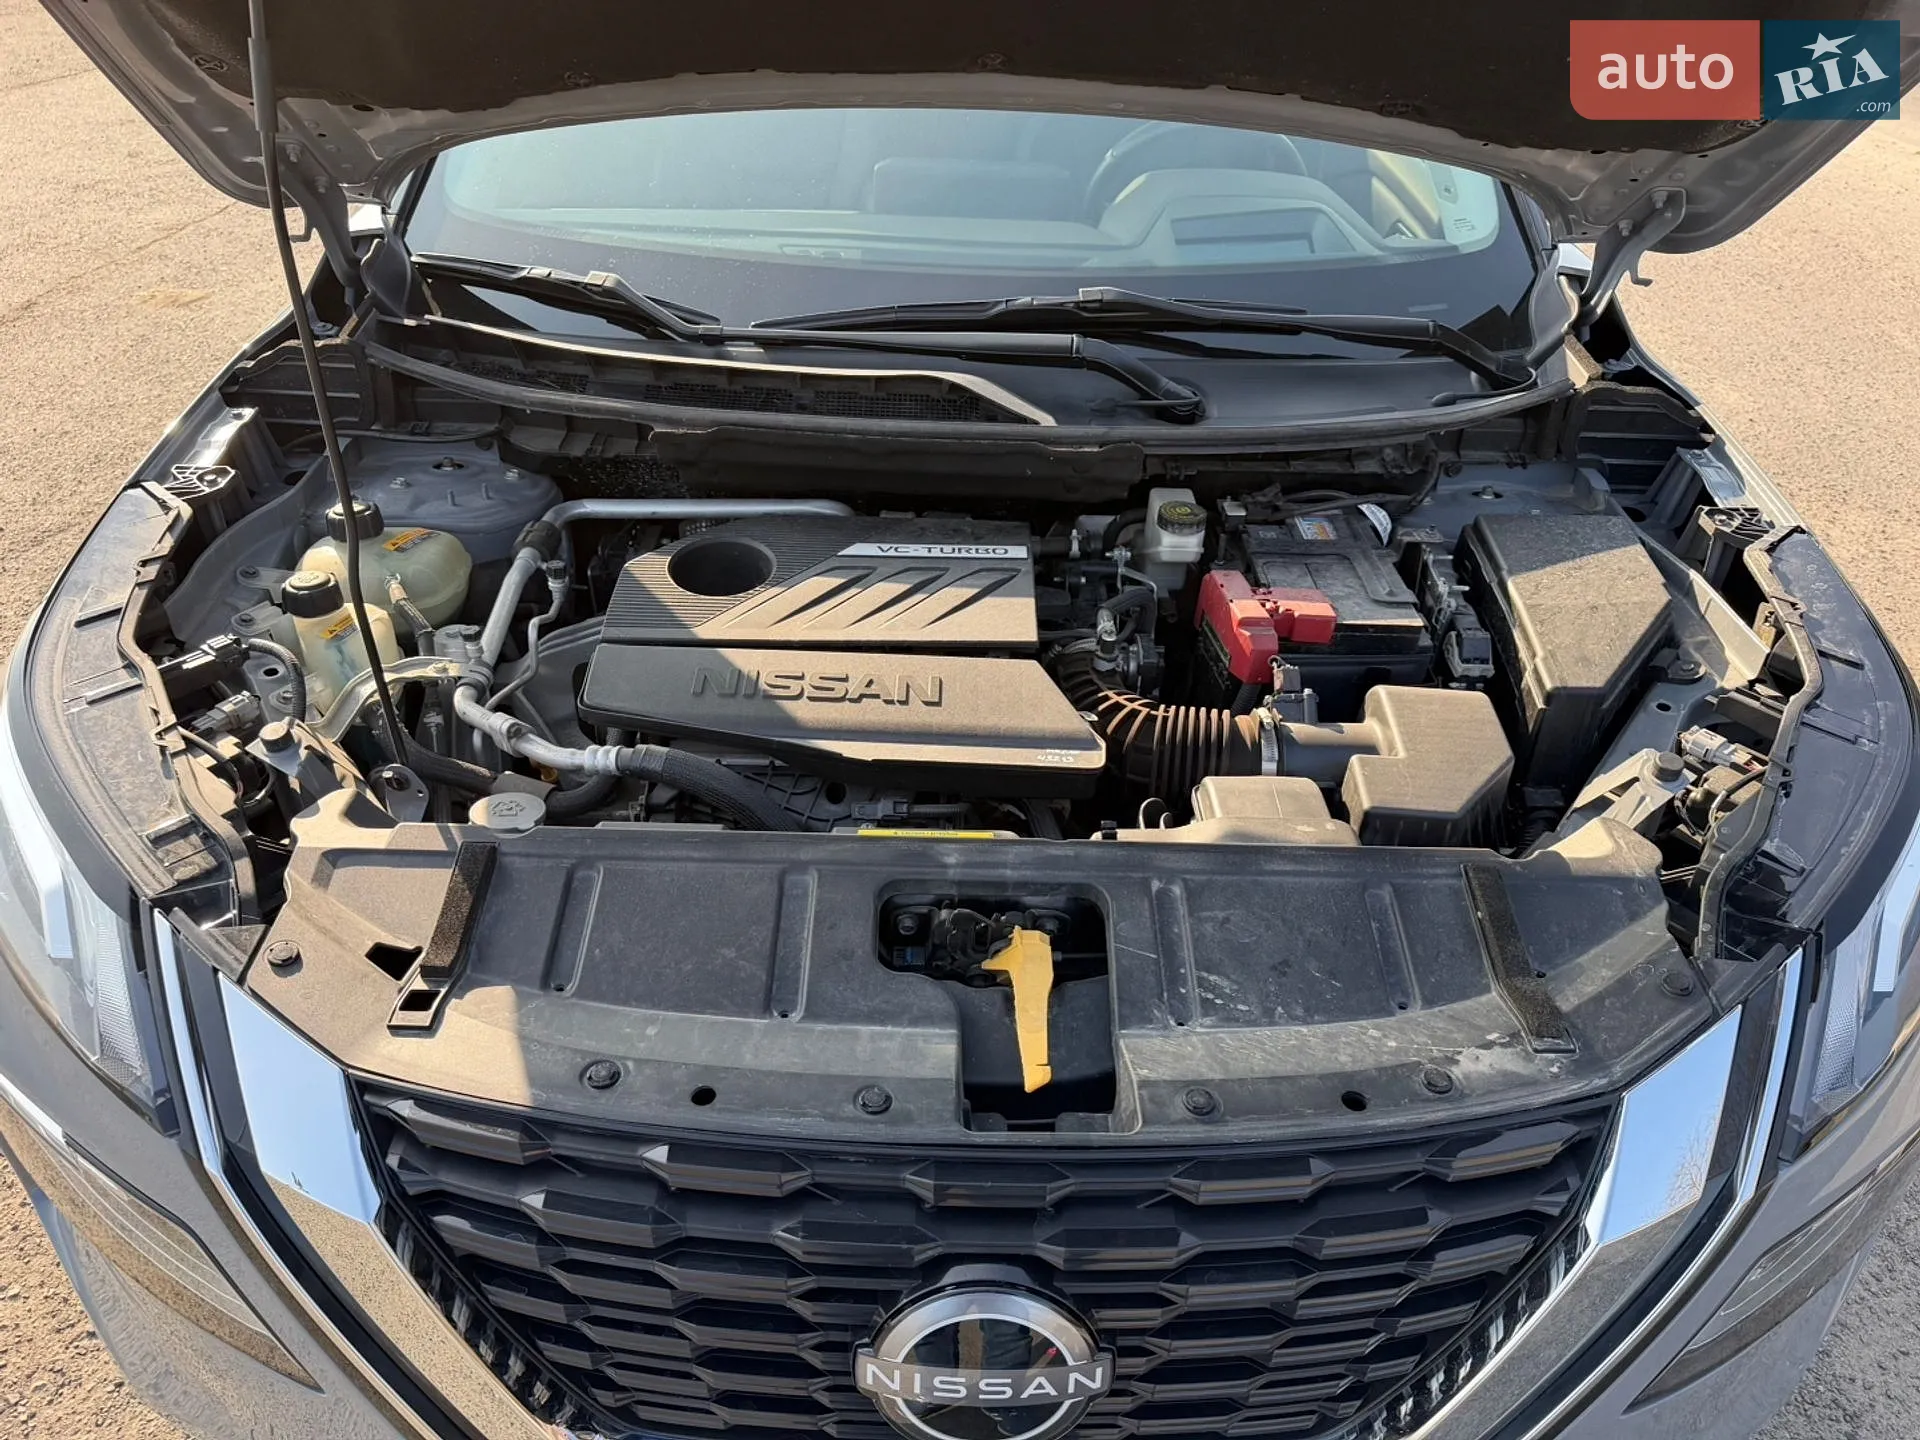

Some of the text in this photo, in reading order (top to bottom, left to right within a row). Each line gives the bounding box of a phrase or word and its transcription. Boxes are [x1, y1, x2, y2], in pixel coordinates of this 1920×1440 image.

[877, 545, 1009, 556] VC-TURBO
[690, 667, 943, 708] NISSAN
[866, 1363, 1103, 1399] NISSAN
